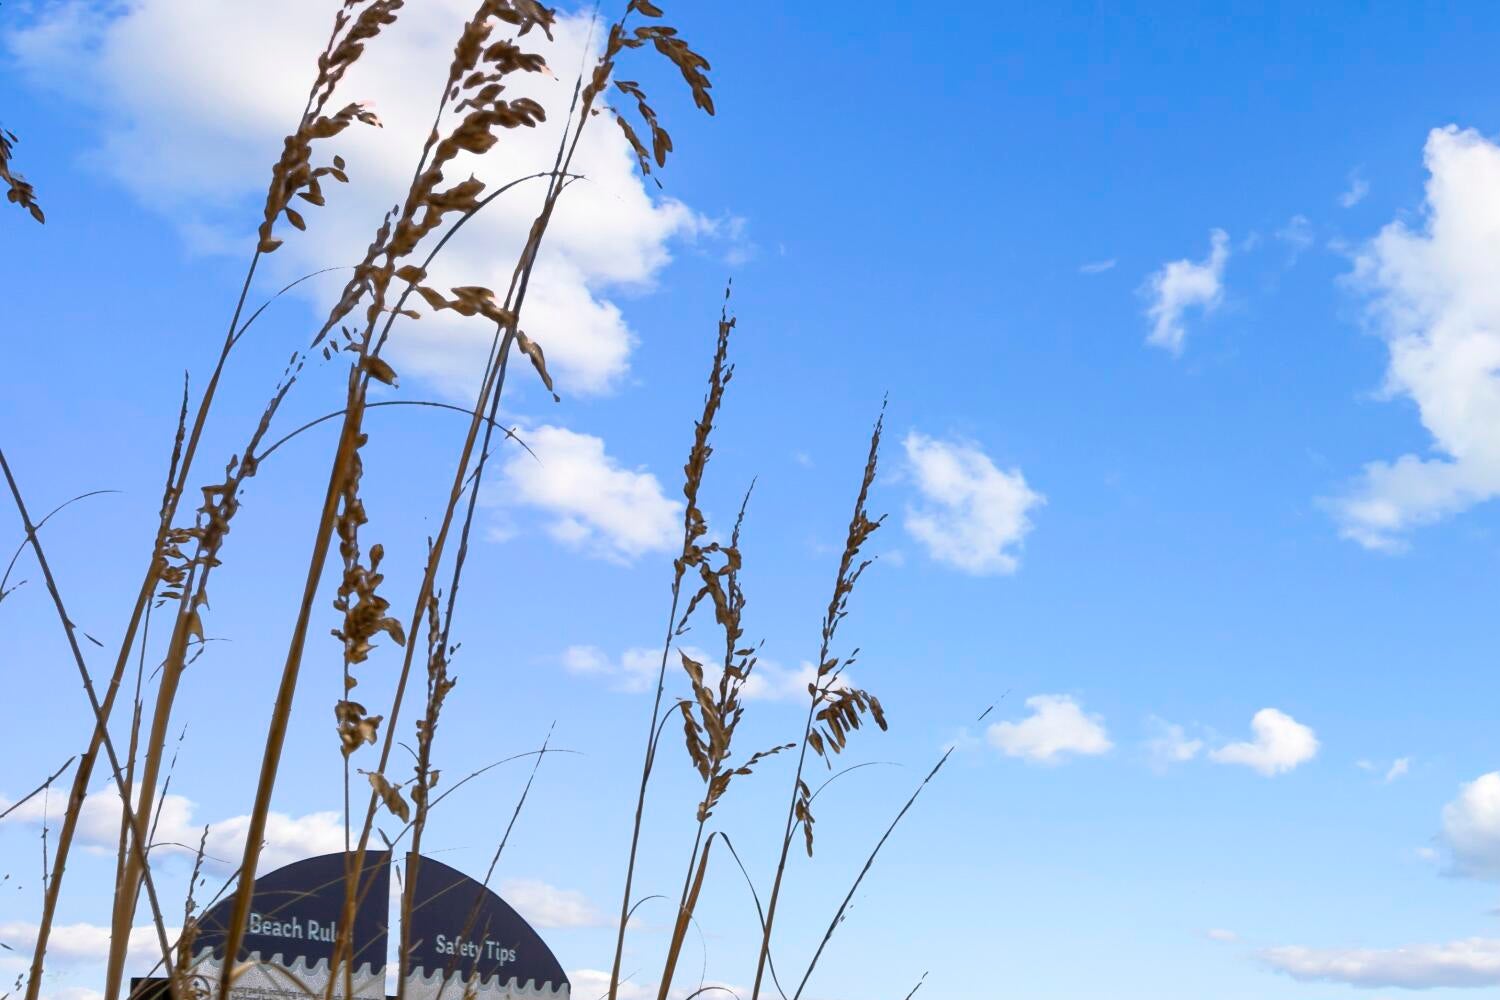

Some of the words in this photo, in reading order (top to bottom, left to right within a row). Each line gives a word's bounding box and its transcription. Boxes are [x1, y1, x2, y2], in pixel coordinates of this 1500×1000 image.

[250, 913, 303, 939] Beach
[307, 919, 346, 943] Rul
[436, 934, 484, 963] Safety
[486, 940, 517, 967] Tips
